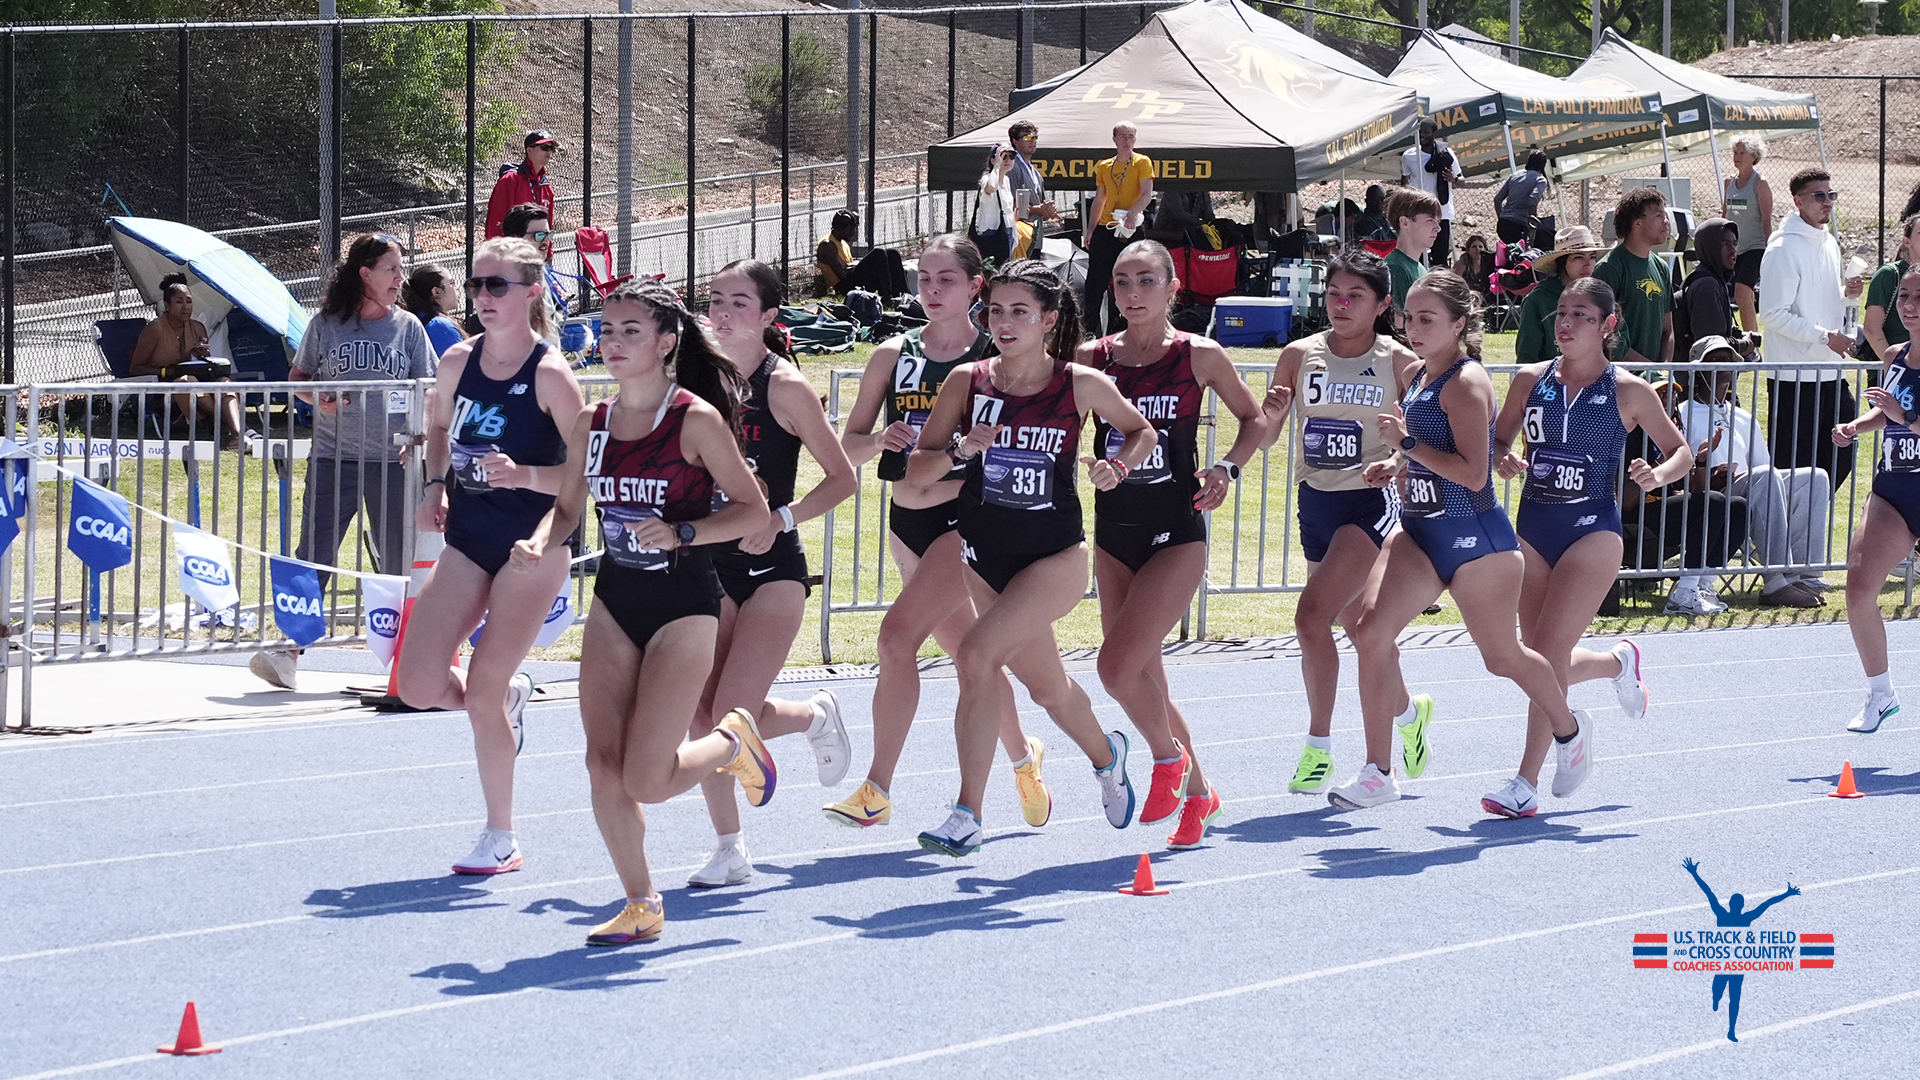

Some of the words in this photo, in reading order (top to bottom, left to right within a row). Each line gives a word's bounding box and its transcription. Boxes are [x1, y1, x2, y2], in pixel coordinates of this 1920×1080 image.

[1082, 82, 1184, 119] CPP
[1521, 98, 1551, 114] CAL
[1553, 98, 1584, 114] POLY
[1587, 98, 1646, 114] POMONA
[1725, 104, 1746, 121] CAL
[1746, 105, 1772, 121] POLY
[1771, 105, 1810, 120] POMONA
[1326, 140, 1345, 165] CAL
[1342, 129, 1362, 156] POLY
[1362, 114, 1396, 146] POMONA
[1031, 159, 1101, 178] RACK
[1153, 160, 1212, 178] IELD
[899, 358, 918, 390] 2
[1884, 366, 1901, 391] 7
[1308, 373, 1323, 405] 5
[464, 401, 507, 438] MB
[1137, 395, 1179, 420] STATE
[1527, 408, 1540, 441] 6
[588, 433, 602, 473] 9
[1016, 425, 1067, 454] STATE
[1327, 433, 1357, 458] 536
[1898, 437, 1920, 461] 384
[1133, 444, 1164, 470] 28
[586, 476, 616, 502] HICO
[619, 477, 669, 505] STATE
[1012, 466, 1046, 496] 331
[1410, 478, 1437, 504] 381
[1554, 464, 1585, 491] 385
[75, 515, 128, 546] CCAA
[187, 558, 227, 582] CCAA
[276, 592, 321, 617] CCAA
